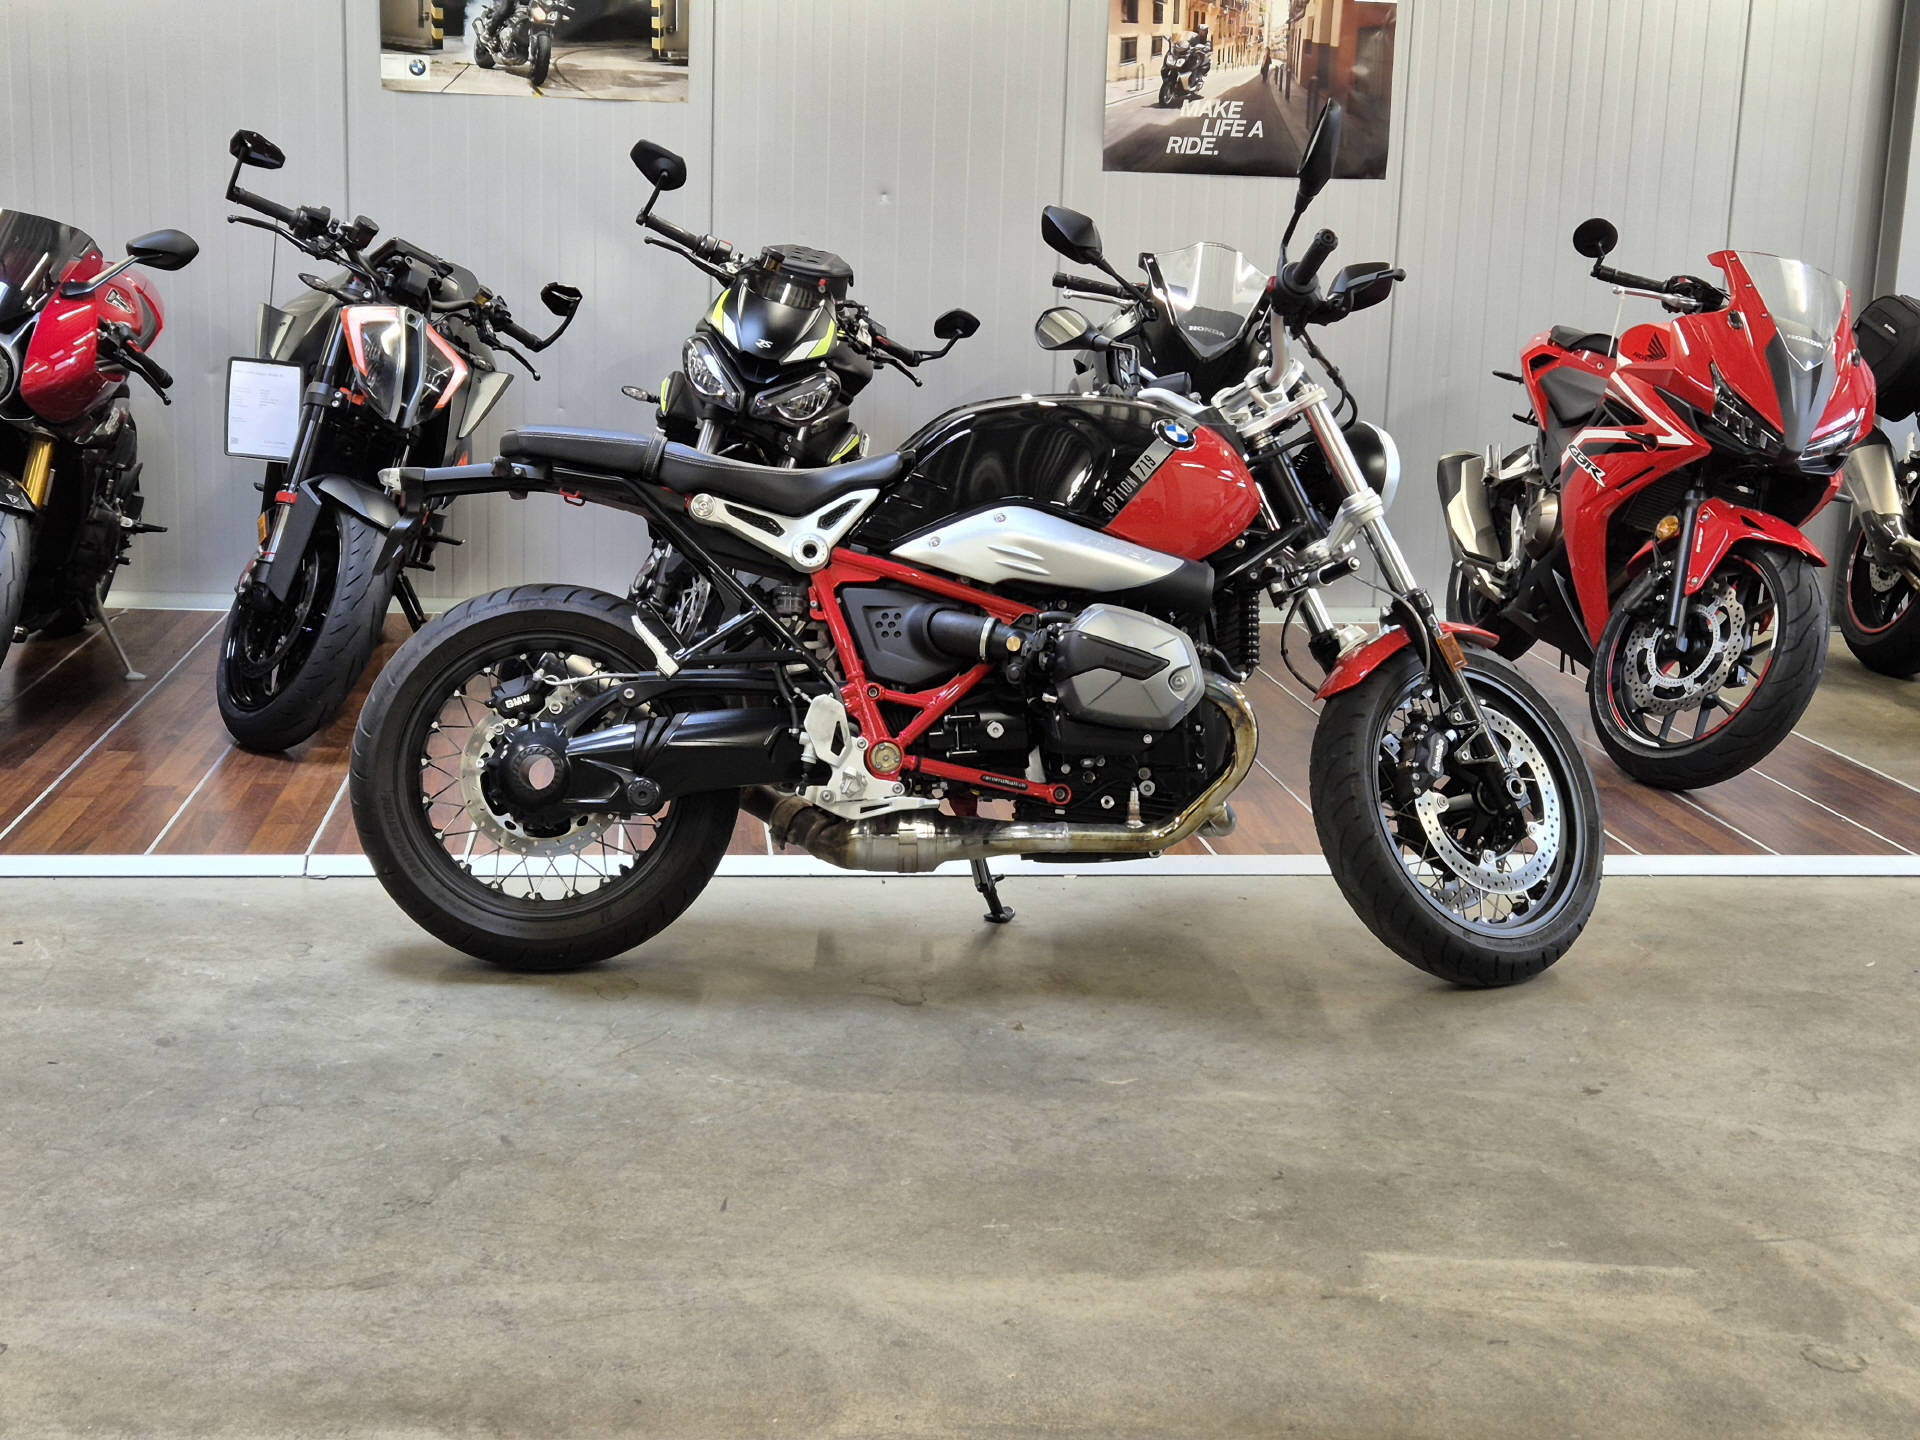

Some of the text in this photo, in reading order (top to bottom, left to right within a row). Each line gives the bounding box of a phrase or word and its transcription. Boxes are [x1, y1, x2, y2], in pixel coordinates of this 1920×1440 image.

[1180, 99, 1244, 119] MAKE
[1201, 119, 1264, 138] LIFE A
[1165, 136, 1219, 156] RIDE.
[1188, 325, 1226, 338] HONDA
[1567, 443, 1606, 488] CBR
[1102, 454, 1156, 513] OPTION 719
[504, 693, 531, 709] BMW
[1431, 738, 1445, 773] brembo
